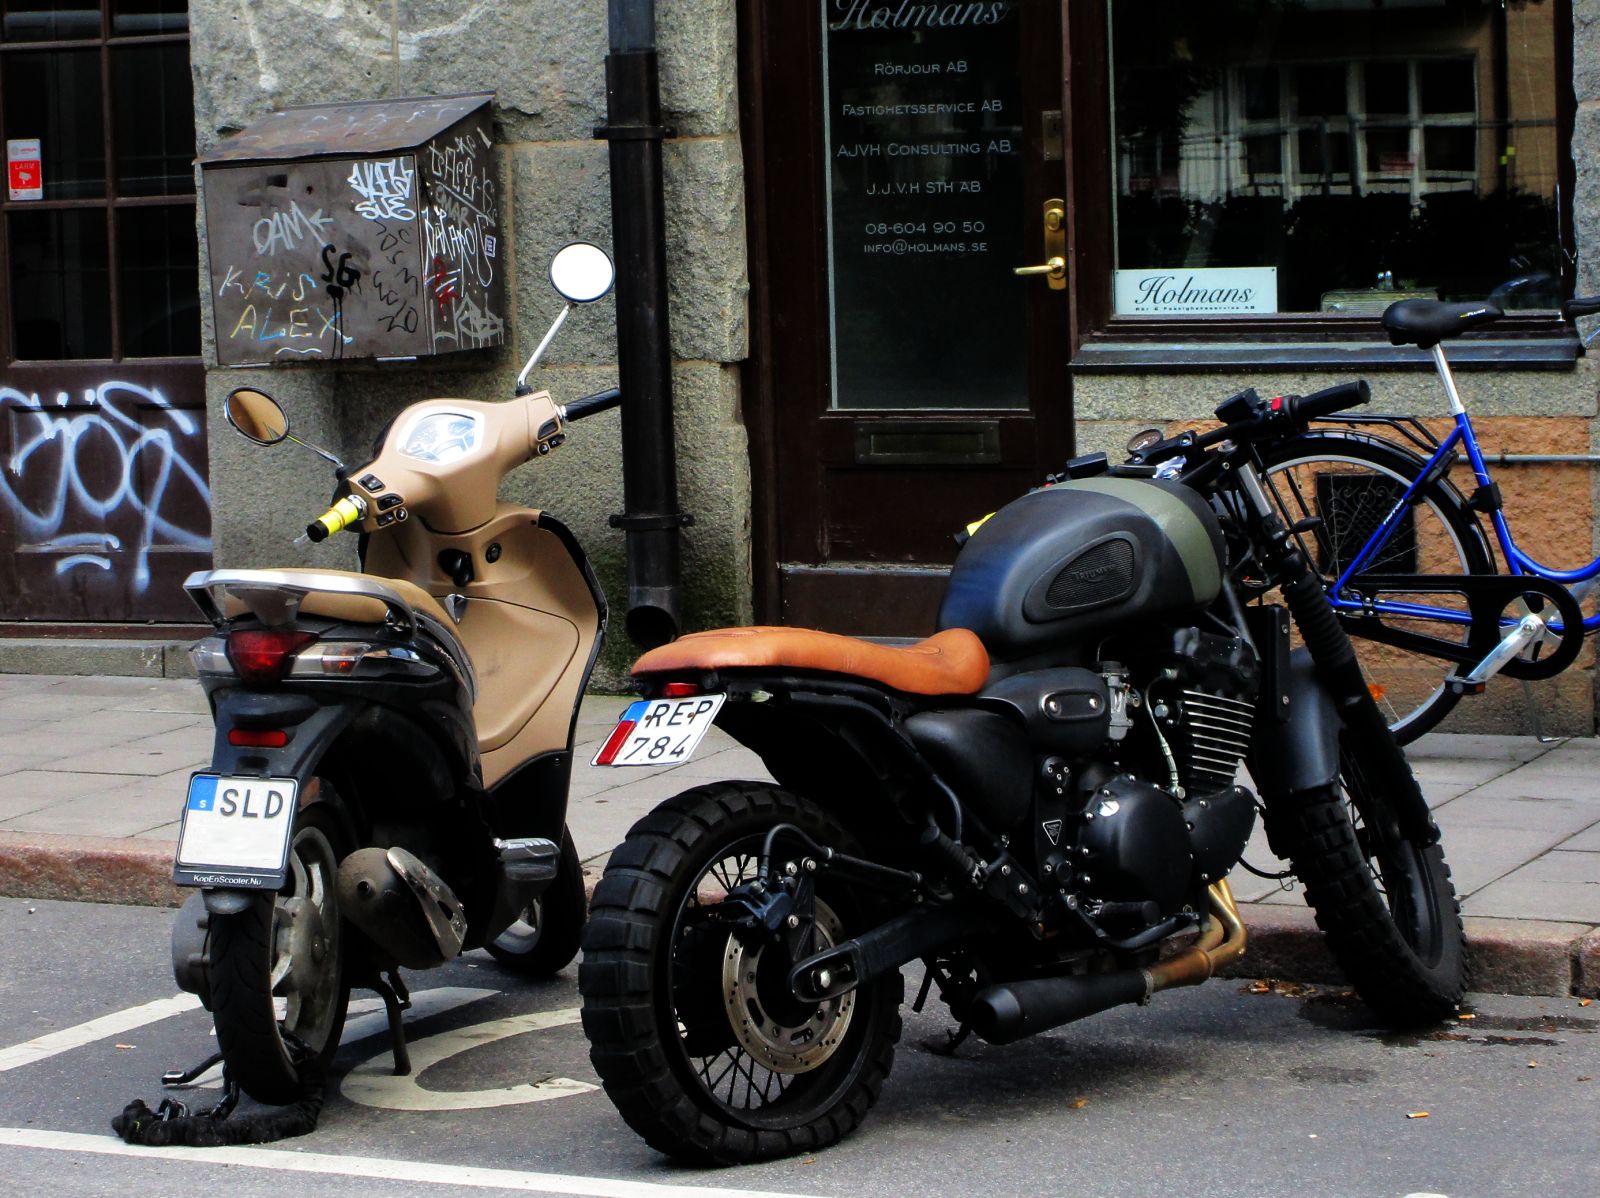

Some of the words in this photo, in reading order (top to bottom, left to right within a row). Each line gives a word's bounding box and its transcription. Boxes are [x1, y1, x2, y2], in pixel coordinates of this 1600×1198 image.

[829, 0, 1009, 31] Holmans
[946, 61, 968, 73] AB
[981, 100, 1003, 112] AB
[837, 143, 881, 157] AJVH
[887, 142, 981, 157] CONSULTING
[987, 140, 1012, 153] AB
[926, 182, 954, 194] STH
[960, 181, 982, 193] AB
[865, 222, 927, 235] 08-604
[933, 222, 956, 233] 90
[962, 221, 985, 233] 50
[1134, 275, 1257, 305] Holmans
[230, 304, 353, 345] ALEX
[645, 700, 713, 728] REP
[624, 734, 691, 760] 784
[199, 800, 207, 808] S
[220, 788, 284, 819] SLD
